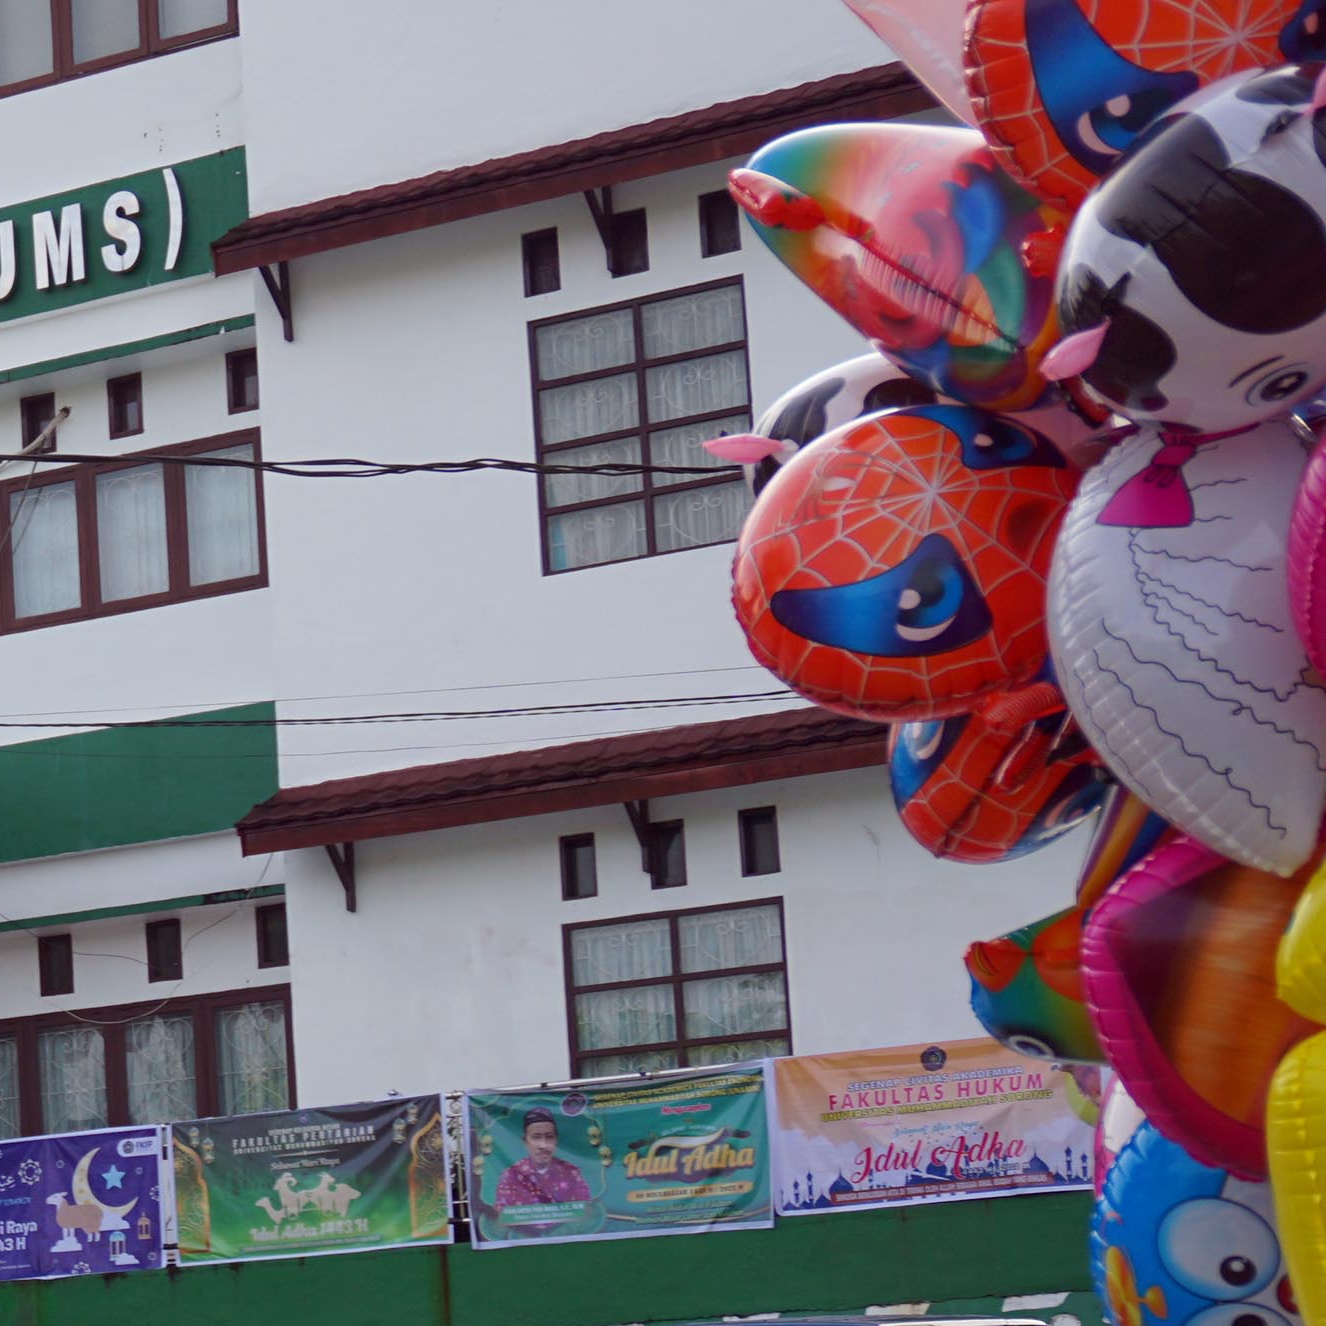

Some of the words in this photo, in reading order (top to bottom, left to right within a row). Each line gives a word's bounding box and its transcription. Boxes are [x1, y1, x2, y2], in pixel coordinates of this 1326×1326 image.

[828, 1084, 944, 1111] FAKULTAS
[957, 1073, 1043, 1098] HUKUM
[848, 1078, 900, 1092] SEGENAP
[905, 1073, 949, 1087] CIVITAS
[951, 1066, 1024, 1082] AKADEMIKA
[821, 1107, 894, 1122] UNIVERSITAS
[896, 1096, 997, 1115] MUHAMMADIYAH
[999, 1089, 1054, 1103] SORONG
[232, 1134, 296, 1149] FAKULTAS
[302, 1125, 374, 1141] PERTANIAN
[623, 1147, 679, 1180] Idul
[682, 1143, 755, 1176] Adha
[850, 1139, 923, 1184] Idul
[931, 1131, 1028, 1180] Adha
[6, 1220, 38, 1236] Raya
[15, 1236, 27, 1250] H
